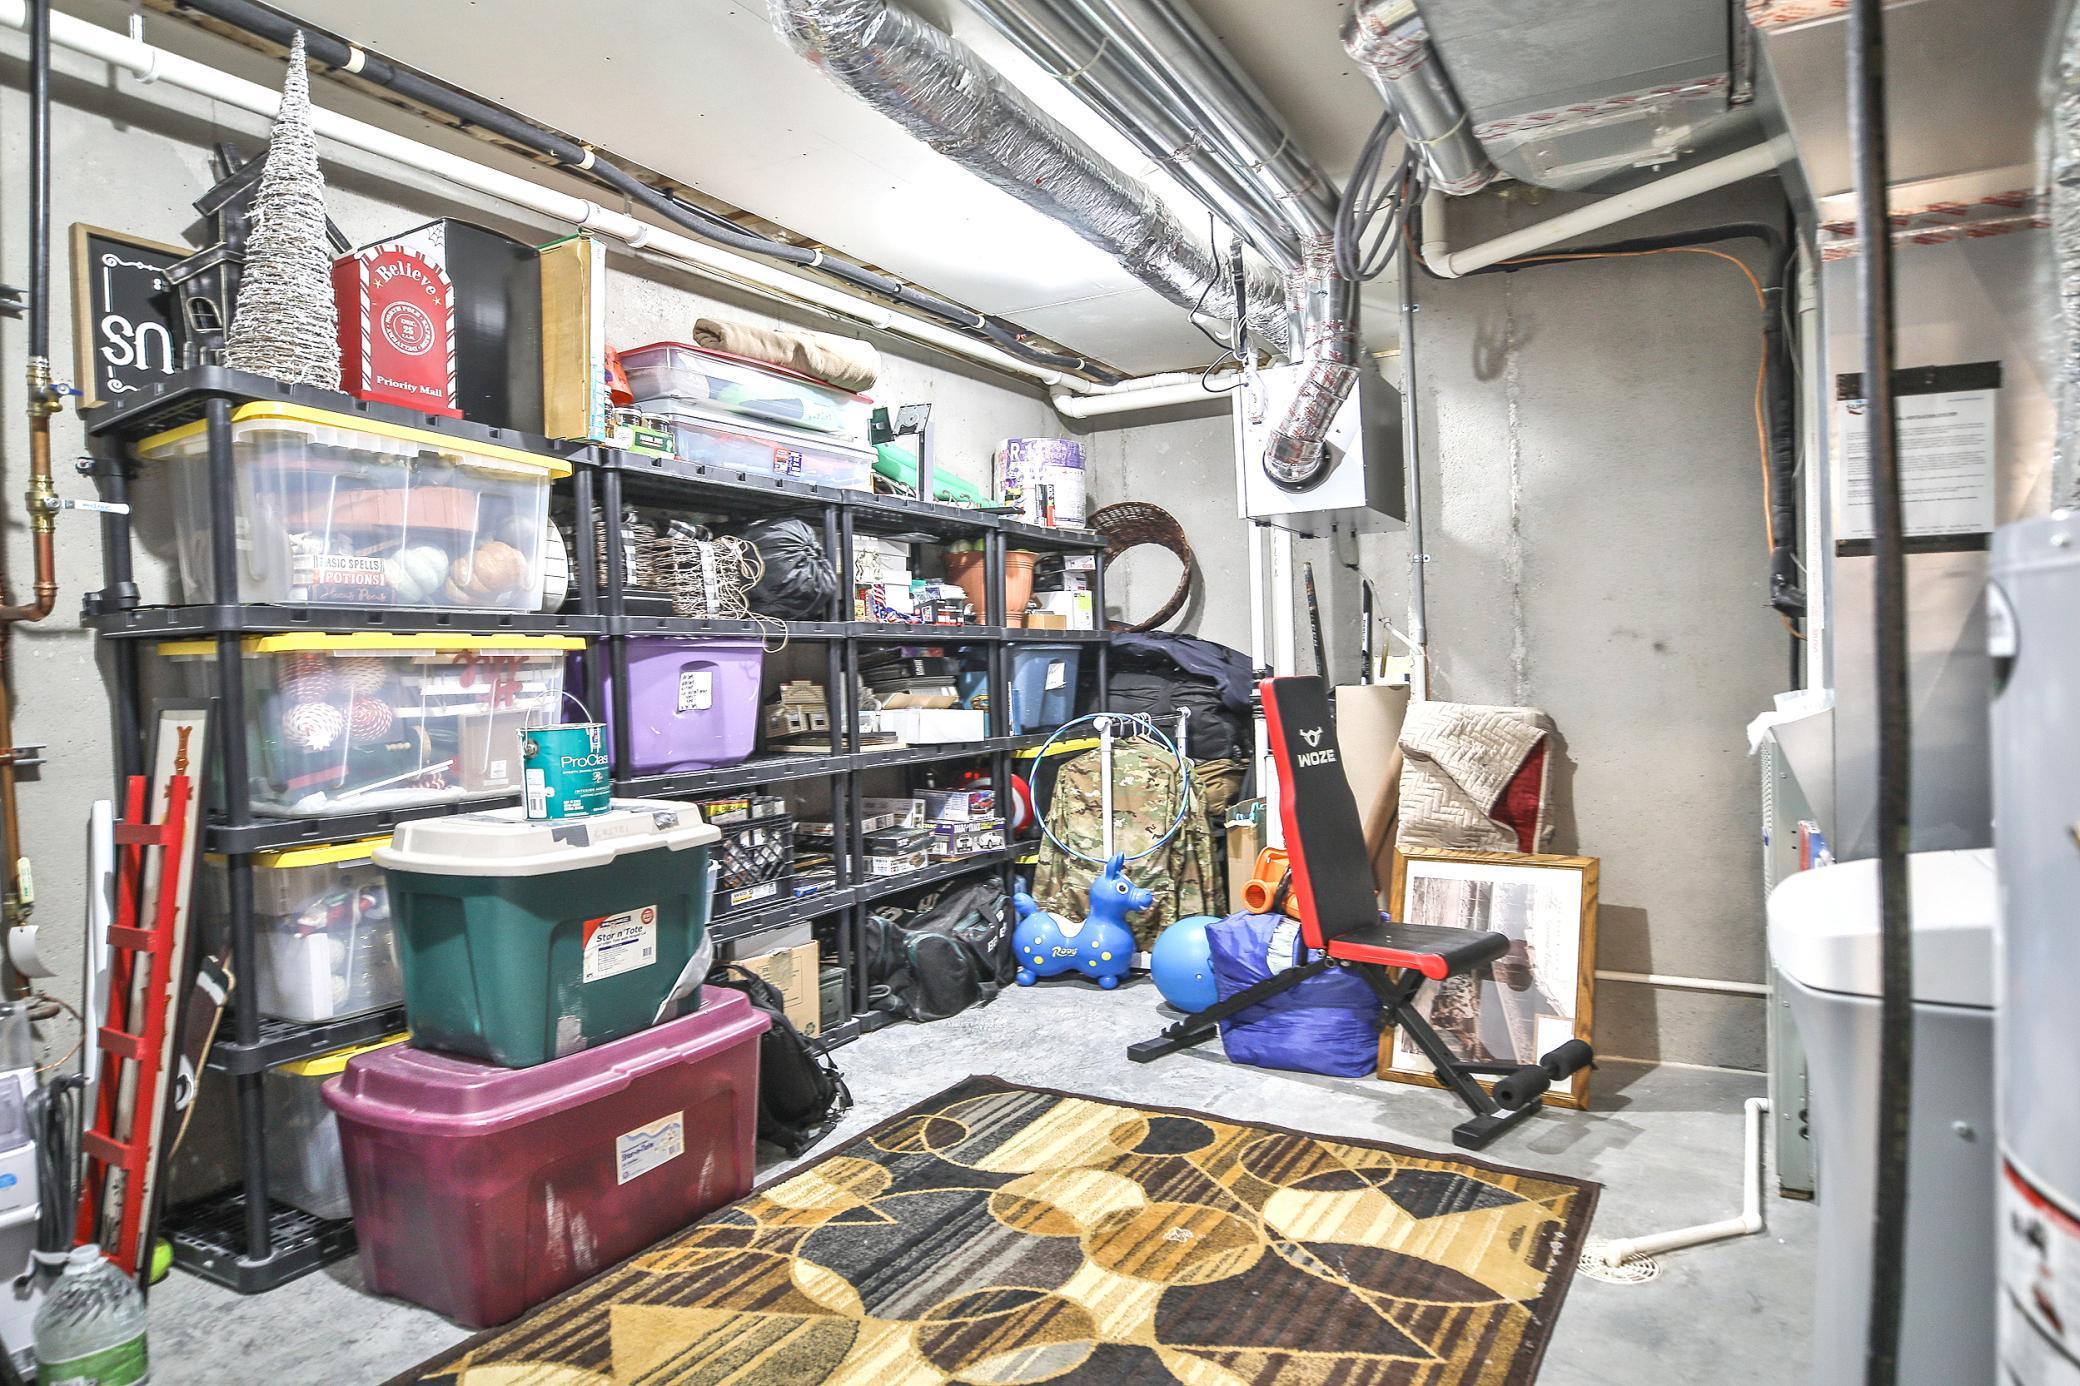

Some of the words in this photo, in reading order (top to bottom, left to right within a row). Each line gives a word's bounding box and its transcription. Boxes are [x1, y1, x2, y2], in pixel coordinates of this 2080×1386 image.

[375, 260, 437, 296] Believe
[376, 375, 418, 394] Priority
[419, 383, 443, 398] Mail
[348, 558, 379, 571] SPELLS
[325, 571, 379, 586] POTIONS
[1297, 748, 1337, 768] WOZE
[596, 932, 616, 943] Stor
